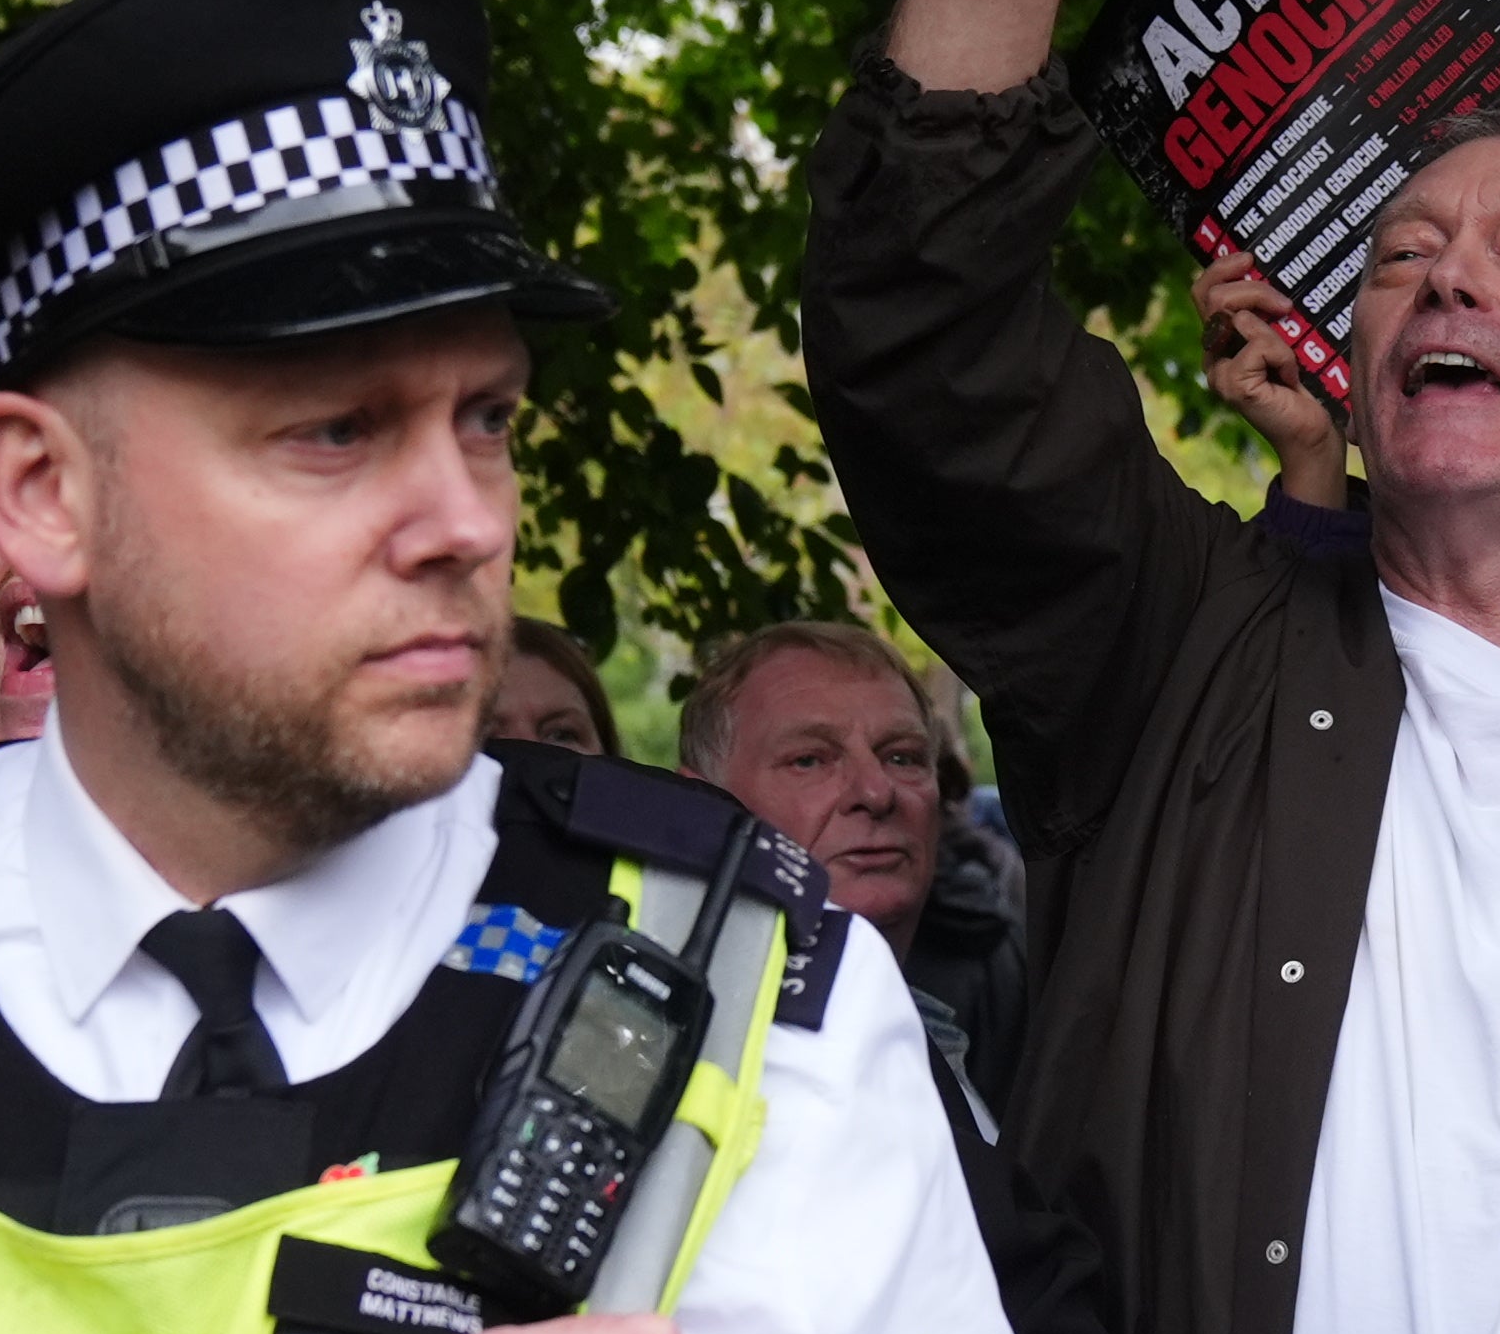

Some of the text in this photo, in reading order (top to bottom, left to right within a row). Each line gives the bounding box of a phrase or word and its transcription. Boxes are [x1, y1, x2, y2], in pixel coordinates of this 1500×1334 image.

[1200, 224, 1217, 243] 1
[1217, 153, 1278, 220] ARMENIAN
[1272, 95, 1333, 158] GENOCIDE
[1369, 19, 1412, 60] MILLION
[1234, 209, 1264, 239] THE
[1257, 136, 1335, 216] HOLOCAUST
[1367, 94, 1381, 109] 6
[1375, 57, 1421, 101] MILLION
[1416, 24, 1454, 62] KILLED
[1254, 187, 1332, 264] CAMBODIAN
[1324, 132, 1389, 196] GENOCIDE
[1423, 60, 1466, 101] MILLION
[1460, 31, 1495, 66] KILLED
[1276, 214, 1350, 290] RWANDAN
[1341, 160, 1410, 227] GENOCIDE
[1303, 340, 1325, 364] 6
[367, 1267, 482, 1313] CONSTABLE
